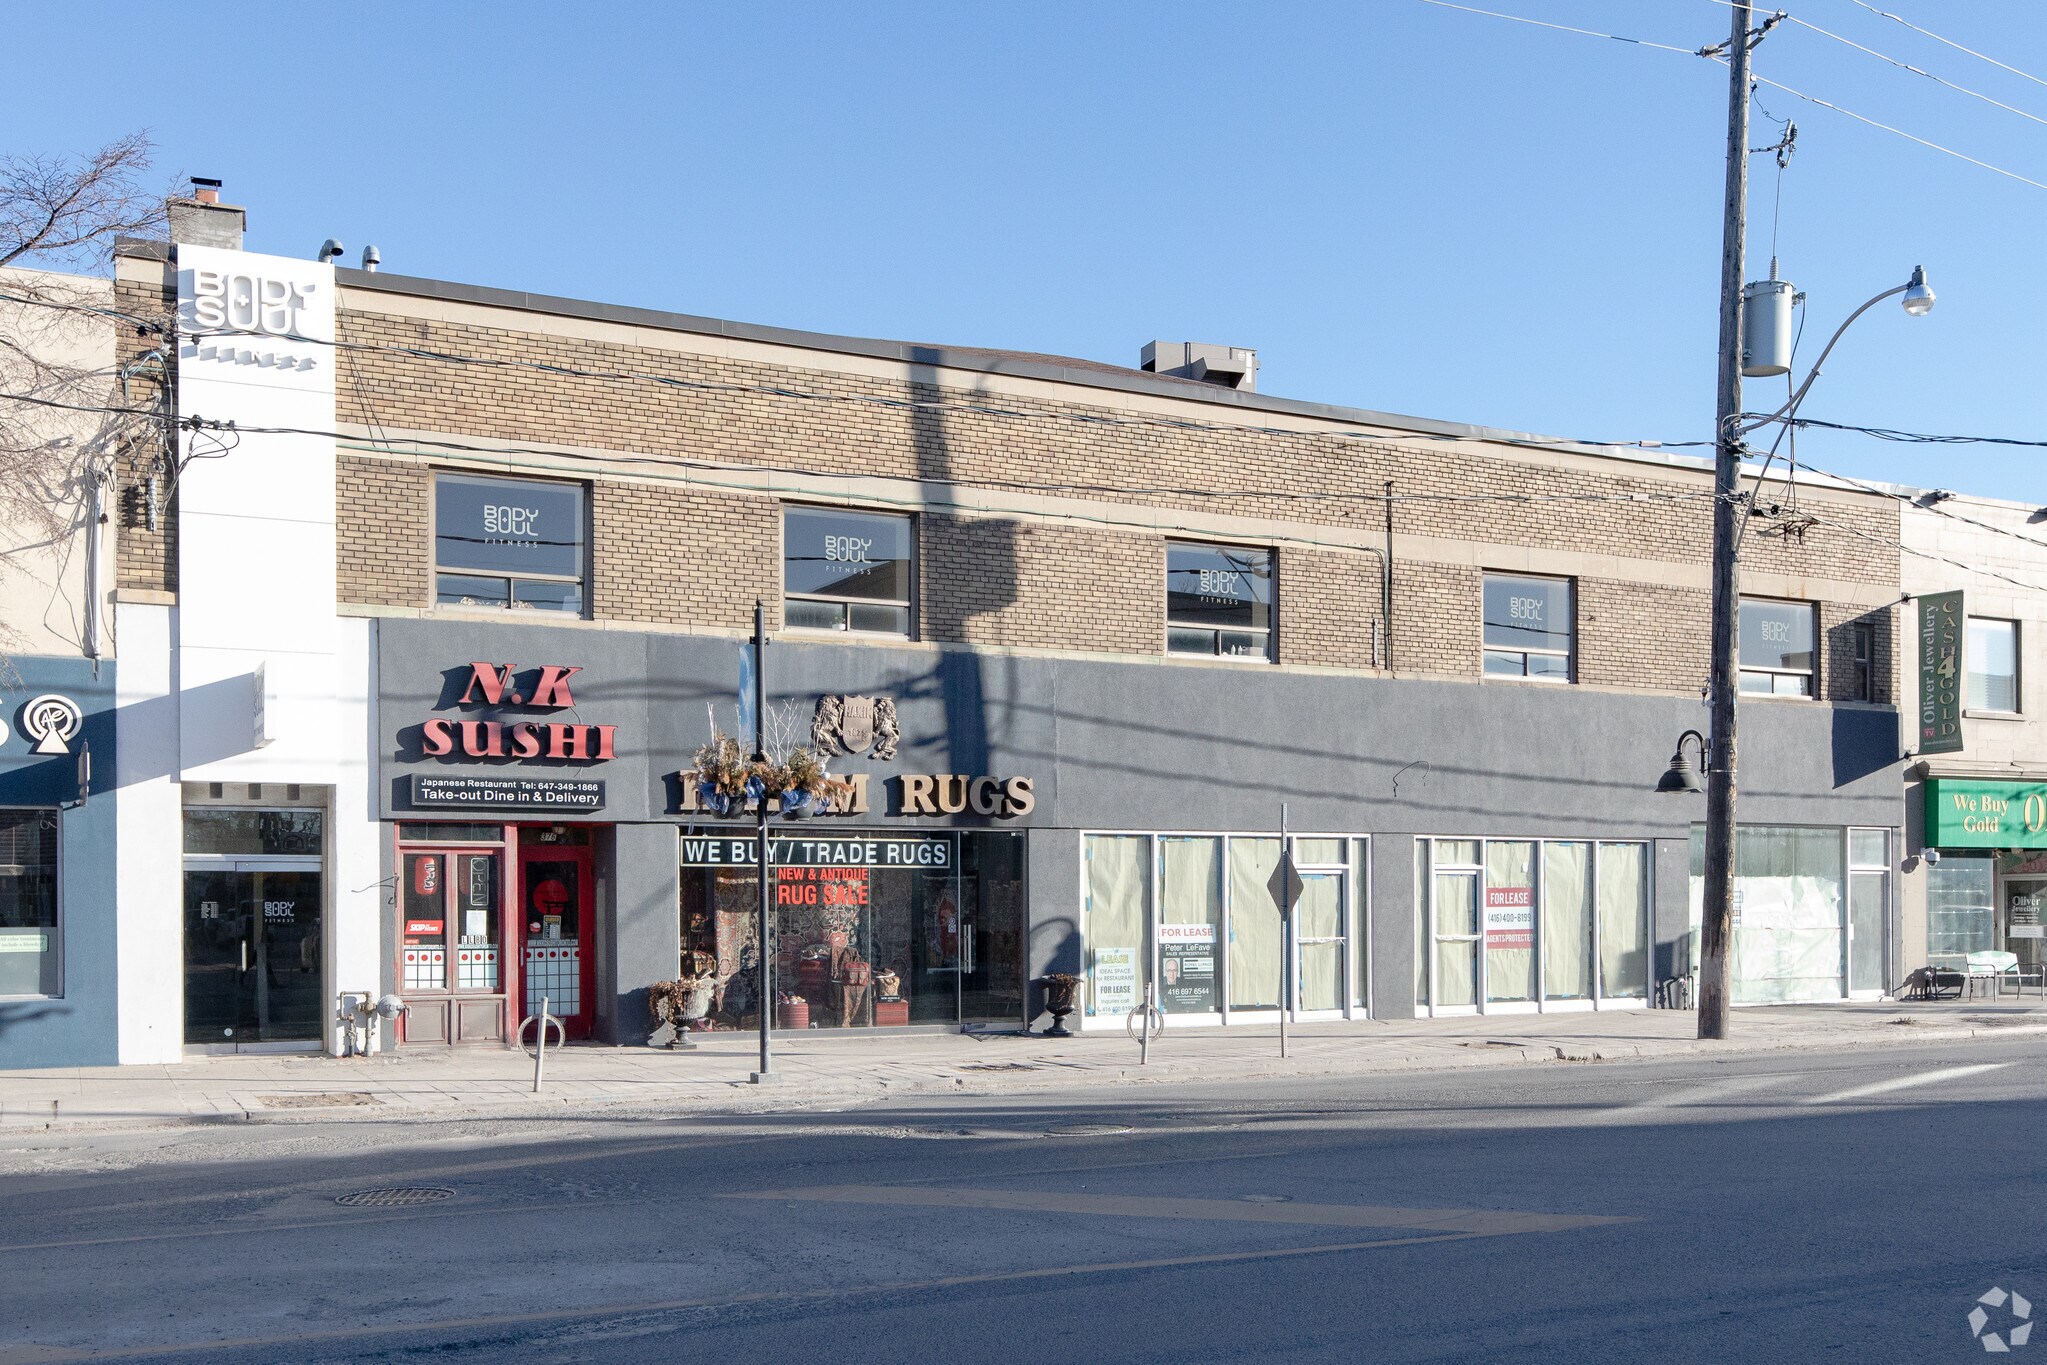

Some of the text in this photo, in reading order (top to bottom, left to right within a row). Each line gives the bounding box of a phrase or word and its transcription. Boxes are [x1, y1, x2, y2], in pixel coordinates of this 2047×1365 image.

[484, 505, 539, 522] BODY
[484, 518, 539, 536] SOUL
[485, 538, 538, 548] FITNESS
[825, 535, 872, 551] BODY
[825, 547, 872, 563] SOUL
[825, 565, 872, 575] FITNESS
[1200, 569, 1239, 583] BODY
[1200, 581, 1239, 595] SOUL
[1200, 596, 1239, 605] FITNESS
[1510, 597, 1543, 610] BODY
[1510, 607, 1543, 620] SOUL
[1761, 620, 1790, 632] BODY
[1761, 630, 1790, 642] SOUL
[1923, 604, 1938, 672] Jewellery
[458, 661, 583, 707] N.K
[1924, 678, 1935, 724] Oliver
[423, 718, 619, 760] SUSHI
[421, 778, 599, 792] Japanese Restaurant Tel: 647-349-1866
[421, 788, 599, 805] Take-out Dine in & Delivery
[900, 774, 1036, 816] RUGS
[1953, 794, 1977, 812] We
[1981, 795, 2010, 817] Buy
[1963, 815, 1999, 832] Gold
[685, 841, 721, 863] WE
[731, 842, 778, 864] BUY
[803, 843, 878, 865] TRADE
[887, 844, 946, 865] RUGS
[472, 859, 487, 904] OPEN
[778, 868, 868, 881] NEW & ANTIQUE
[778, 885, 868, 905] RUG SALE
[2012, 895, 2041, 906] Oliver
[264, 901, 295, 909] BODY
[264, 907, 295, 916] SOUL
[2011, 905, 2040, 914] Jewellery
[1161, 928, 1213, 937] FOR LEASE
[1100, 985, 1131, 994] FOR LEASE
[1193, 987, 1209, 995] 6544
